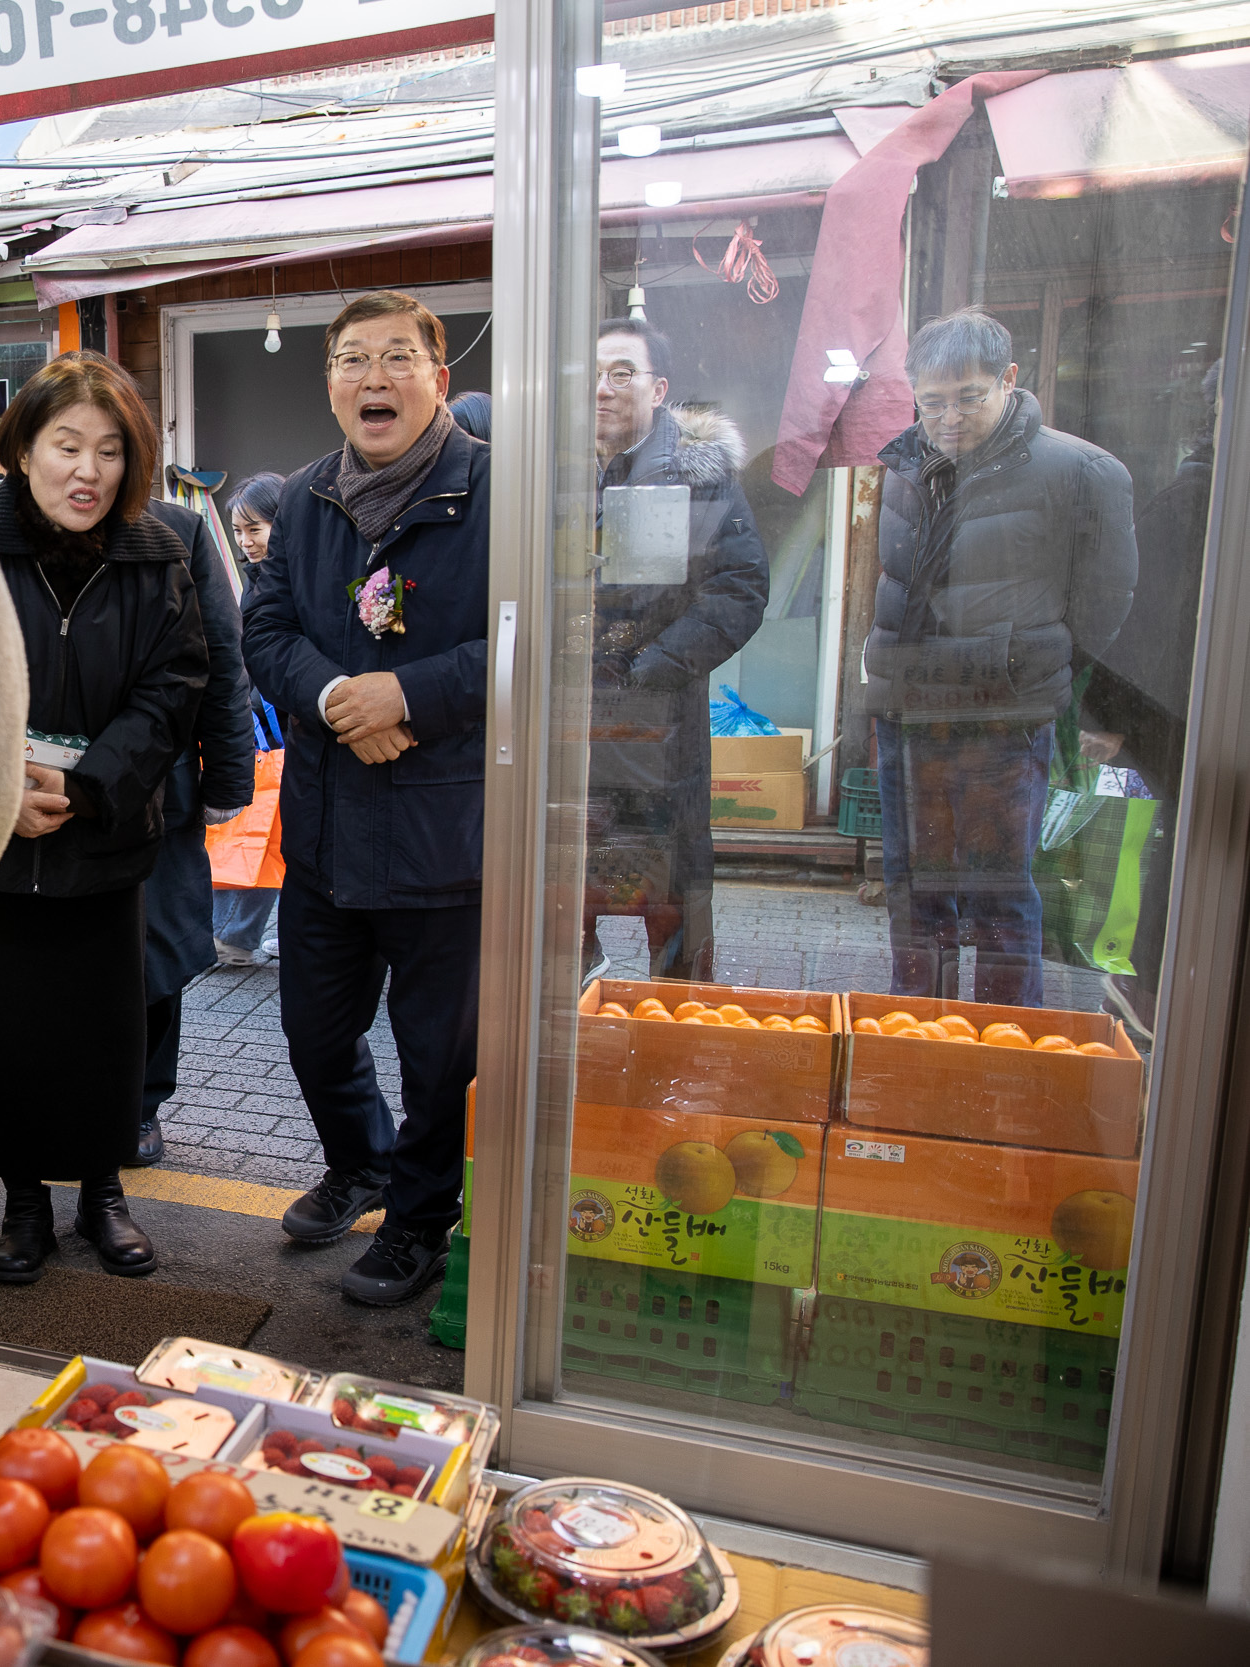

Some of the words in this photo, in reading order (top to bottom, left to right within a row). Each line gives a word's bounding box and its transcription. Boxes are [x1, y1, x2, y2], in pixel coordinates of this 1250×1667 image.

[625, 1186, 656, 1205] 성환
[621, 1210, 727, 1266] 산들배
[1014, 1238, 1051, 1259] 성환
[763, 1260, 790, 1274] 15kg
